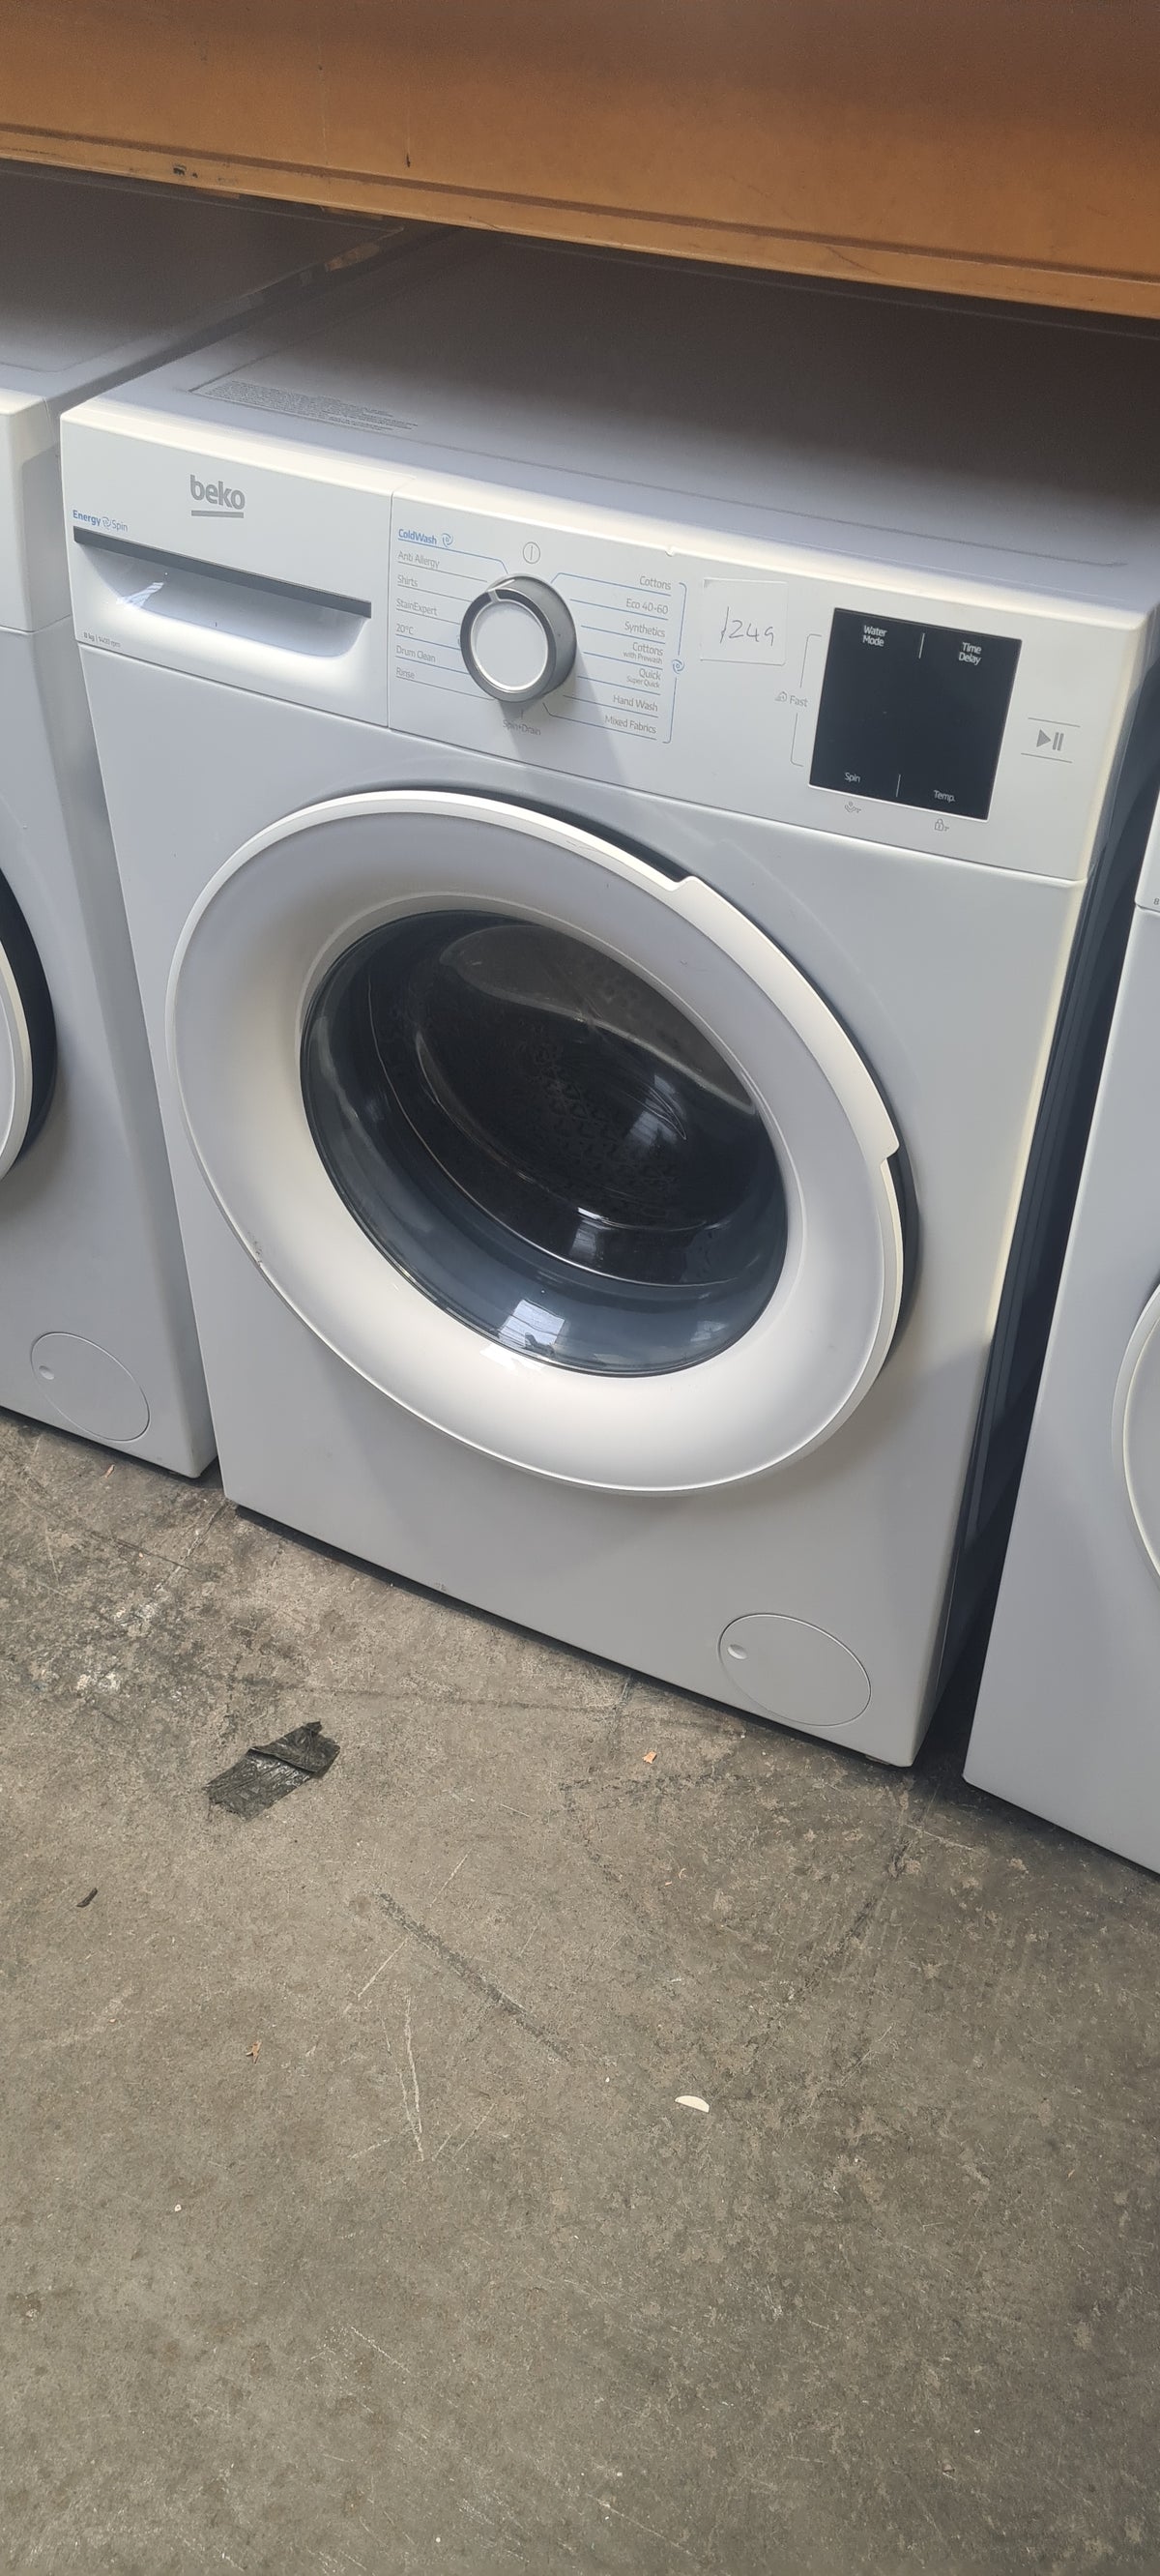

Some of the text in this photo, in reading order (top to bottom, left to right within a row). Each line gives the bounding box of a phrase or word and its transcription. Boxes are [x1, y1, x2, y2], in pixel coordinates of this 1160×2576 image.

[189, 474, 246, 511] beko
[72, 510, 129, 532] Energy Spin
[398, 529, 437, 544] ColdWash
[398, 551, 440, 569] Anti Allergy
[397, 574, 419, 588] Shirts
[639, 575, 672, 590] Cottons
[396, 599, 438, 616] StainExpert
[625, 598, 669, 615] Eco 40-60
[624, 622, 666, 638] Synthetics
[863, 625, 887, 637] Water
[862, 634, 884, 647] Mode
[395, 645, 436, 661] Drum Clean
[623, 651, 636, 659] with
[632, 641, 664, 657] Cottons
[962, 642, 982, 655] Time
[958, 652, 982, 666] Delay
[395, 667, 416, 680] Rinse
[639, 667, 661, 682] Quick
[643, 678, 660, 689] Quick
[613, 694, 658, 713] Hand Wash
[789, 694, 808, 708] Fast
[604, 715, 657, 735] Mixed Fabrics
[844, 773, 861, 783] Spin
[933, 789, 955, 803] Temp.
